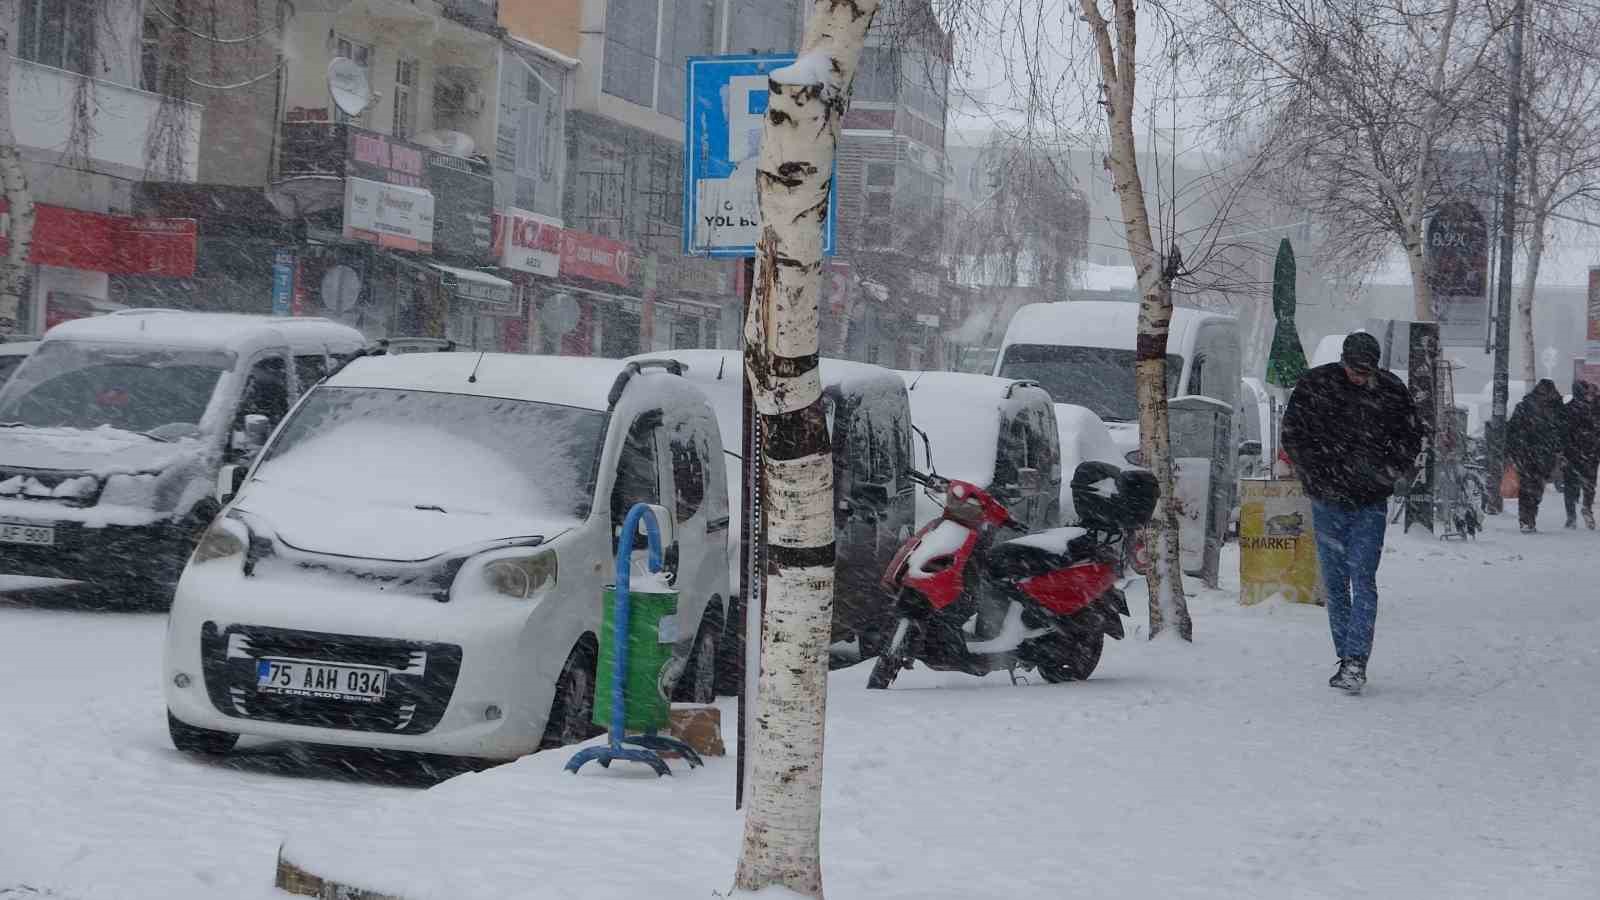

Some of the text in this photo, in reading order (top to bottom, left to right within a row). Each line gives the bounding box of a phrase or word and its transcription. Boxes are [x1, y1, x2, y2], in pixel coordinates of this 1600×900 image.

[705, 216, 735, 227] YOL
[270, 664, 381, 695] 75 AAH 034
